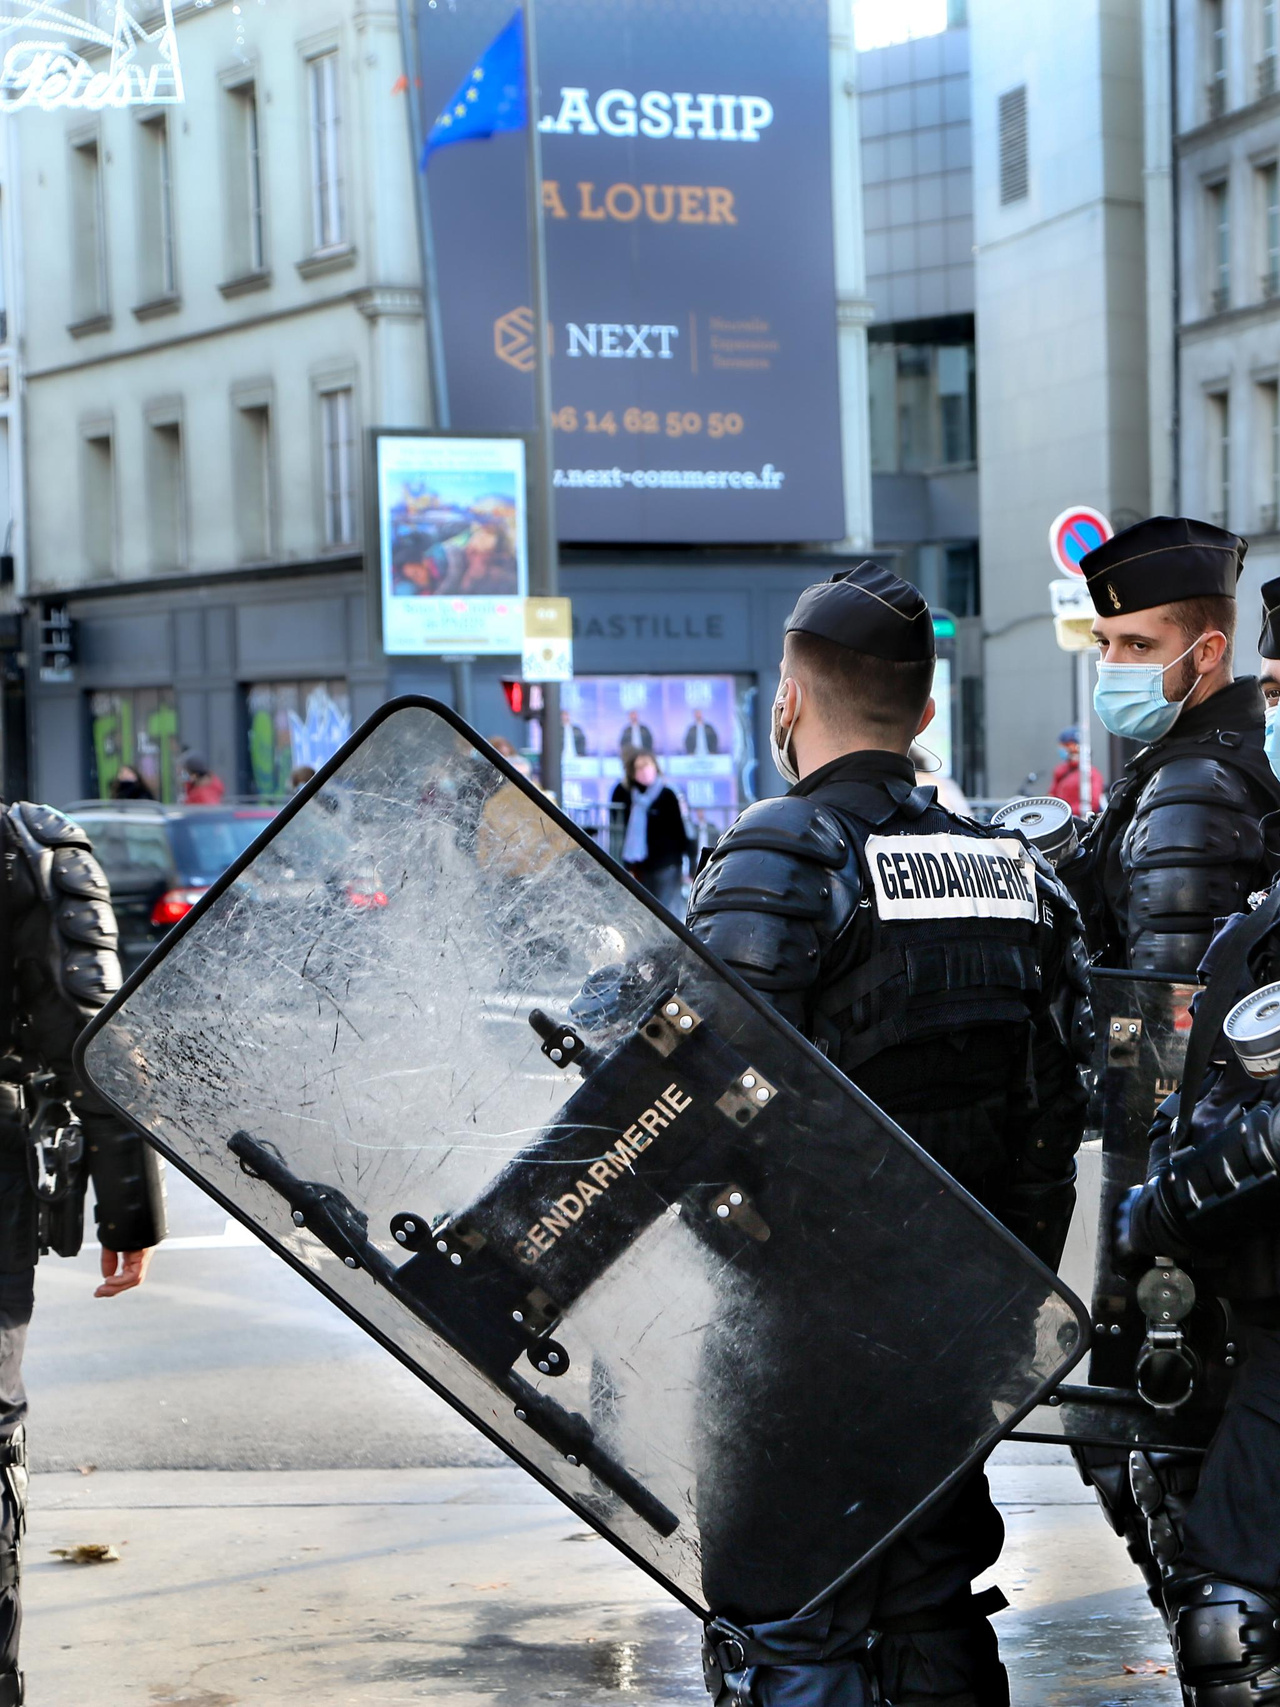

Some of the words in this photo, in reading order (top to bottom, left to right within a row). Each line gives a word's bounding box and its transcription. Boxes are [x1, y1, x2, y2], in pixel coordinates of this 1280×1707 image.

[579, 182, 738, 225] LOUER
[566, 322, 679, 359] NEXT
[585, 410, 617, 436] 14
[623, 408, 660, 433] 62
[665, 411, 702, 437] 50
[708, 411, 745, 438] 50
[876, 851, 1035, 904] GENDARMERIE
[515, 1079, 695, 1268] GENDARMERIE
